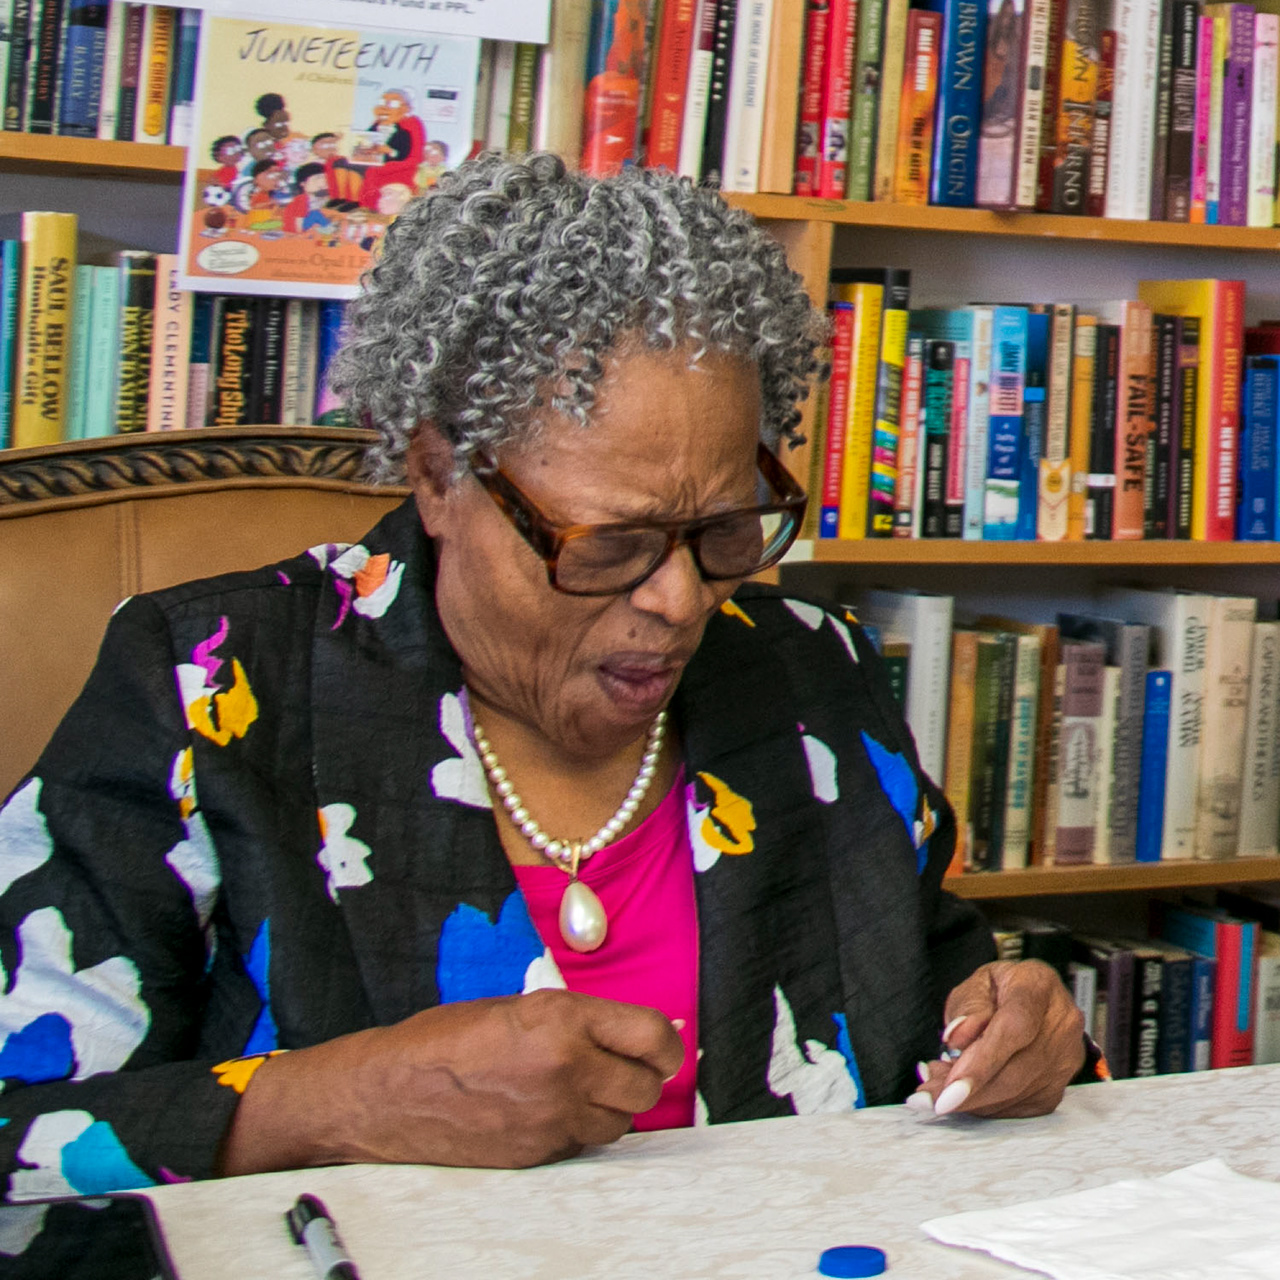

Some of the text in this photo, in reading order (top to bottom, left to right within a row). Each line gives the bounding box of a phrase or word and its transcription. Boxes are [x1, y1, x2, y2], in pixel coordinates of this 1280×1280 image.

[239, 28, 440, 72] JUNETEENTH
[426, 1, 444, 11] at
[952, 2, 978, 92] BROWN
[69, 45, 88, 100] BARRY
[914, 28, 934, 92] DALE BROWN
[945, 114, 973, 197] ORIGIN
[1062, 103, 1092, 207] INFERNO
[21, 266, 47, 405] Humboldt's Gift
[41, 256, 70, 421] SAUL BELLOW
[161, 321, 180, 431] CLEMENTINE
[1122, 373, 1148, 493] FAIL-SAFE
